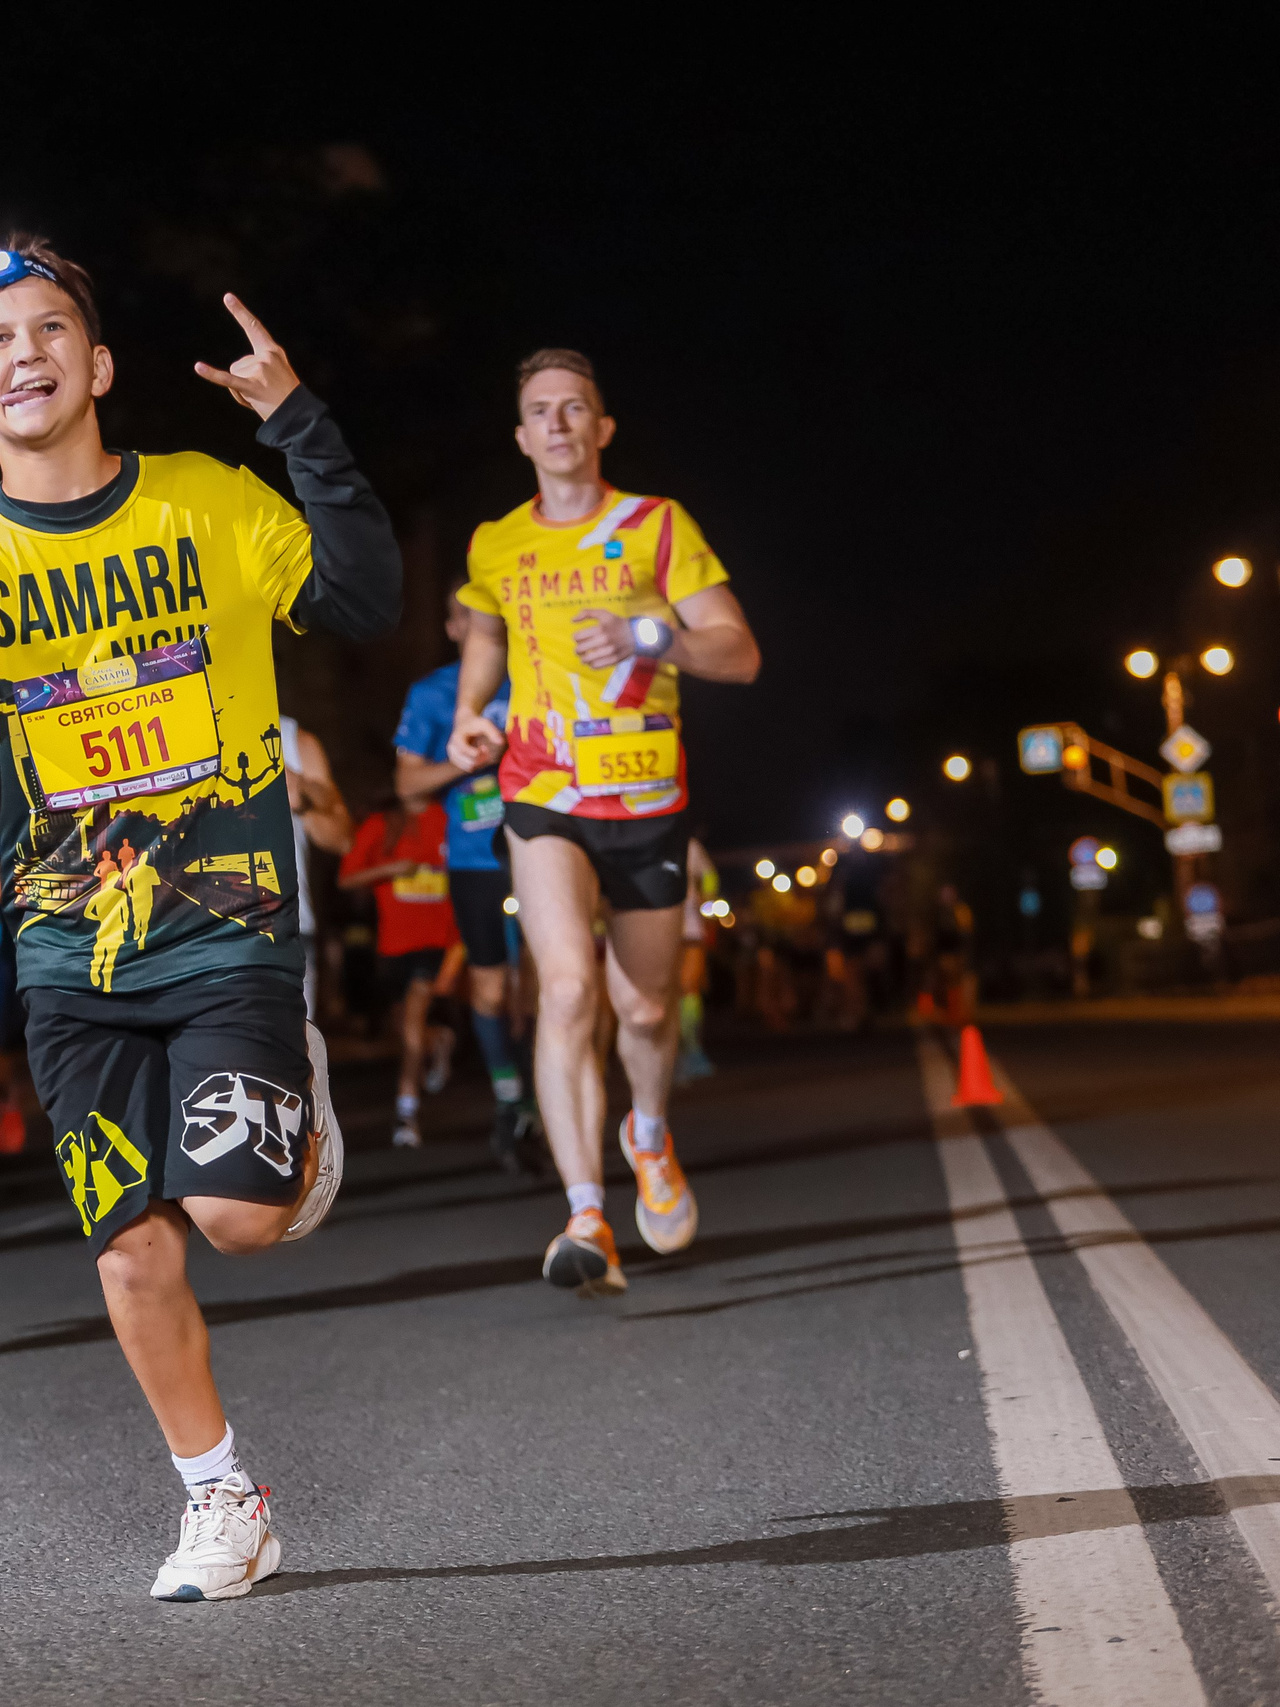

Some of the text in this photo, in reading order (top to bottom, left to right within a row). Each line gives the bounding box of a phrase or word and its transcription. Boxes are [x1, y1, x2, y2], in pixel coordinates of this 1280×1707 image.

[501, 563, 636, 603] SAMARA
[84, 668, 131, 686] САМАРЫ
[57, 688, 175, 727] СВЯТОСЛАВ
[80, 716, 171, 778] 5111
[599, 750, 660, 780] 5532
